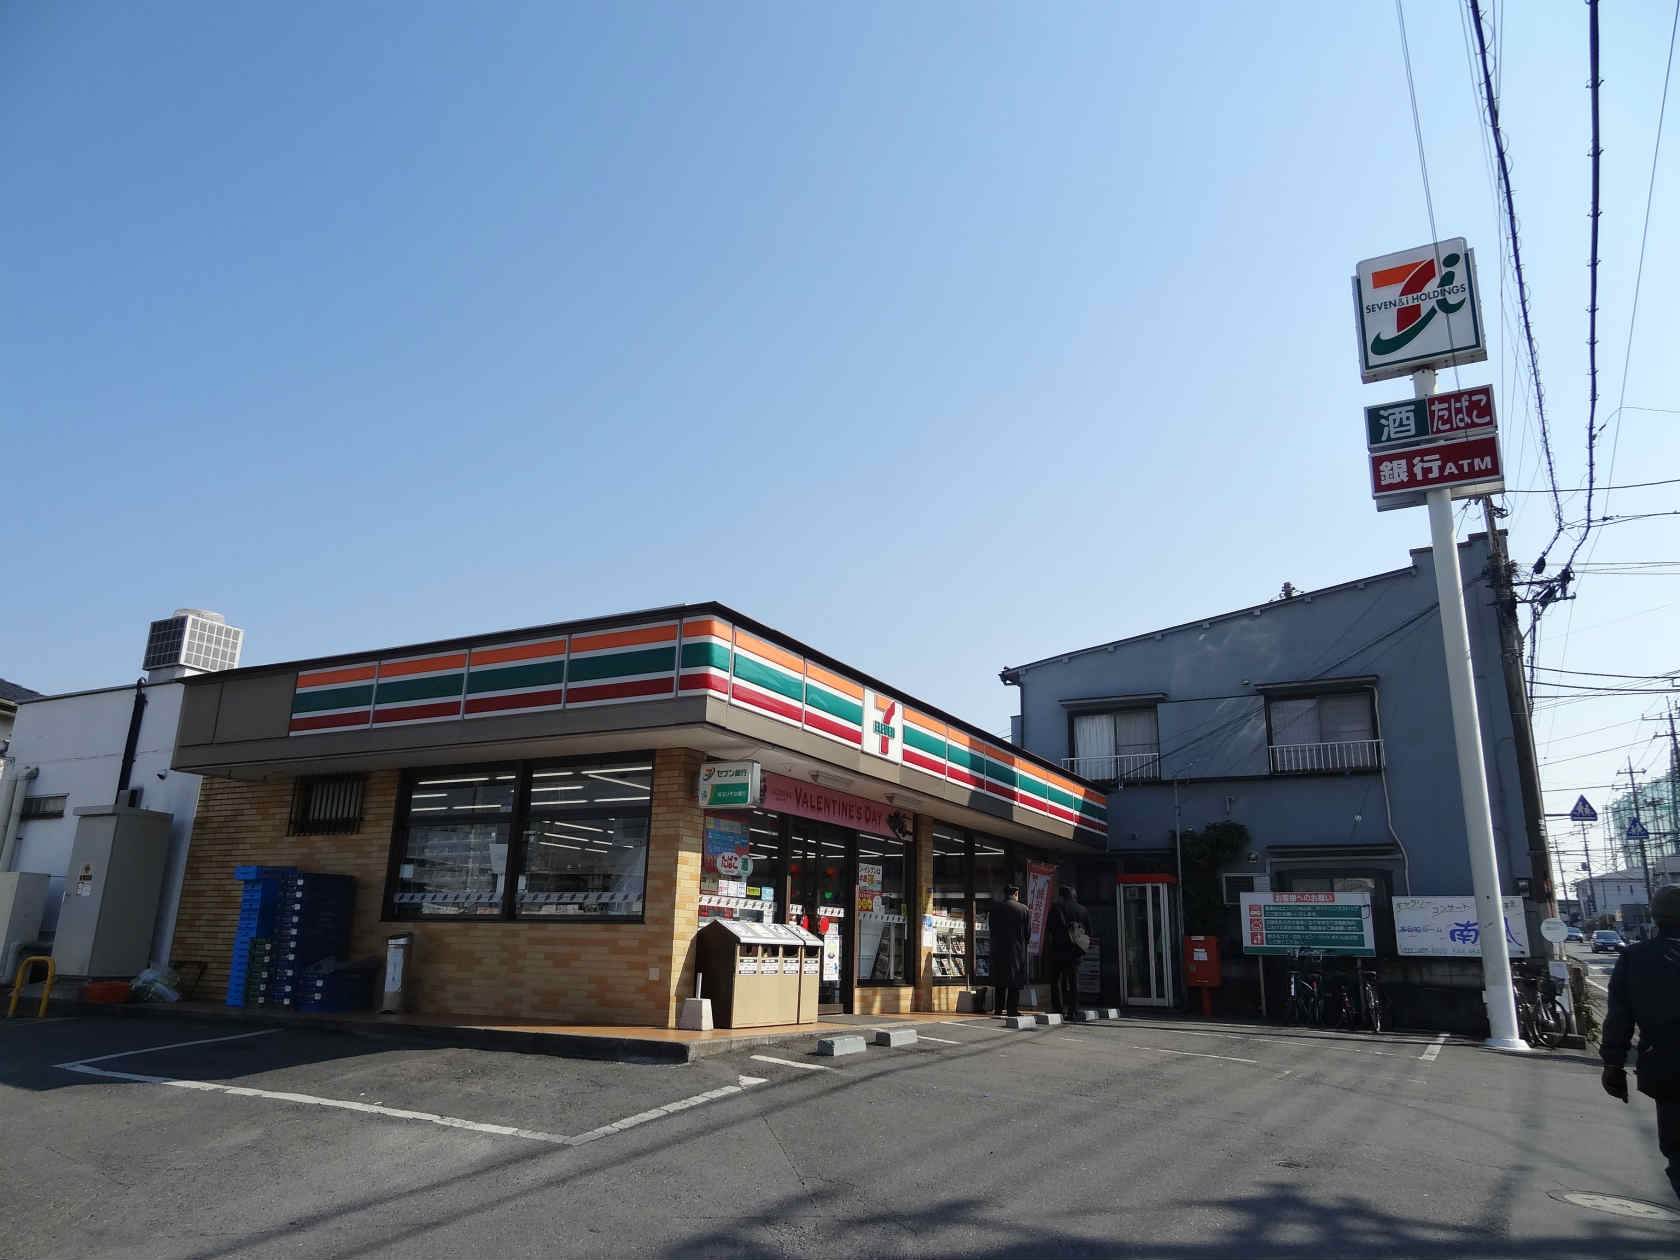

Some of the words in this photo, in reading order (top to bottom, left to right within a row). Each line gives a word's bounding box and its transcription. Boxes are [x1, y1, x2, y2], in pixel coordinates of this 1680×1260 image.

[1411, 283, 1467, 305] HOLDINGS
[1378, 405, 1416, 442] 酒
[1430, 394, 1491, 432] たばこ
